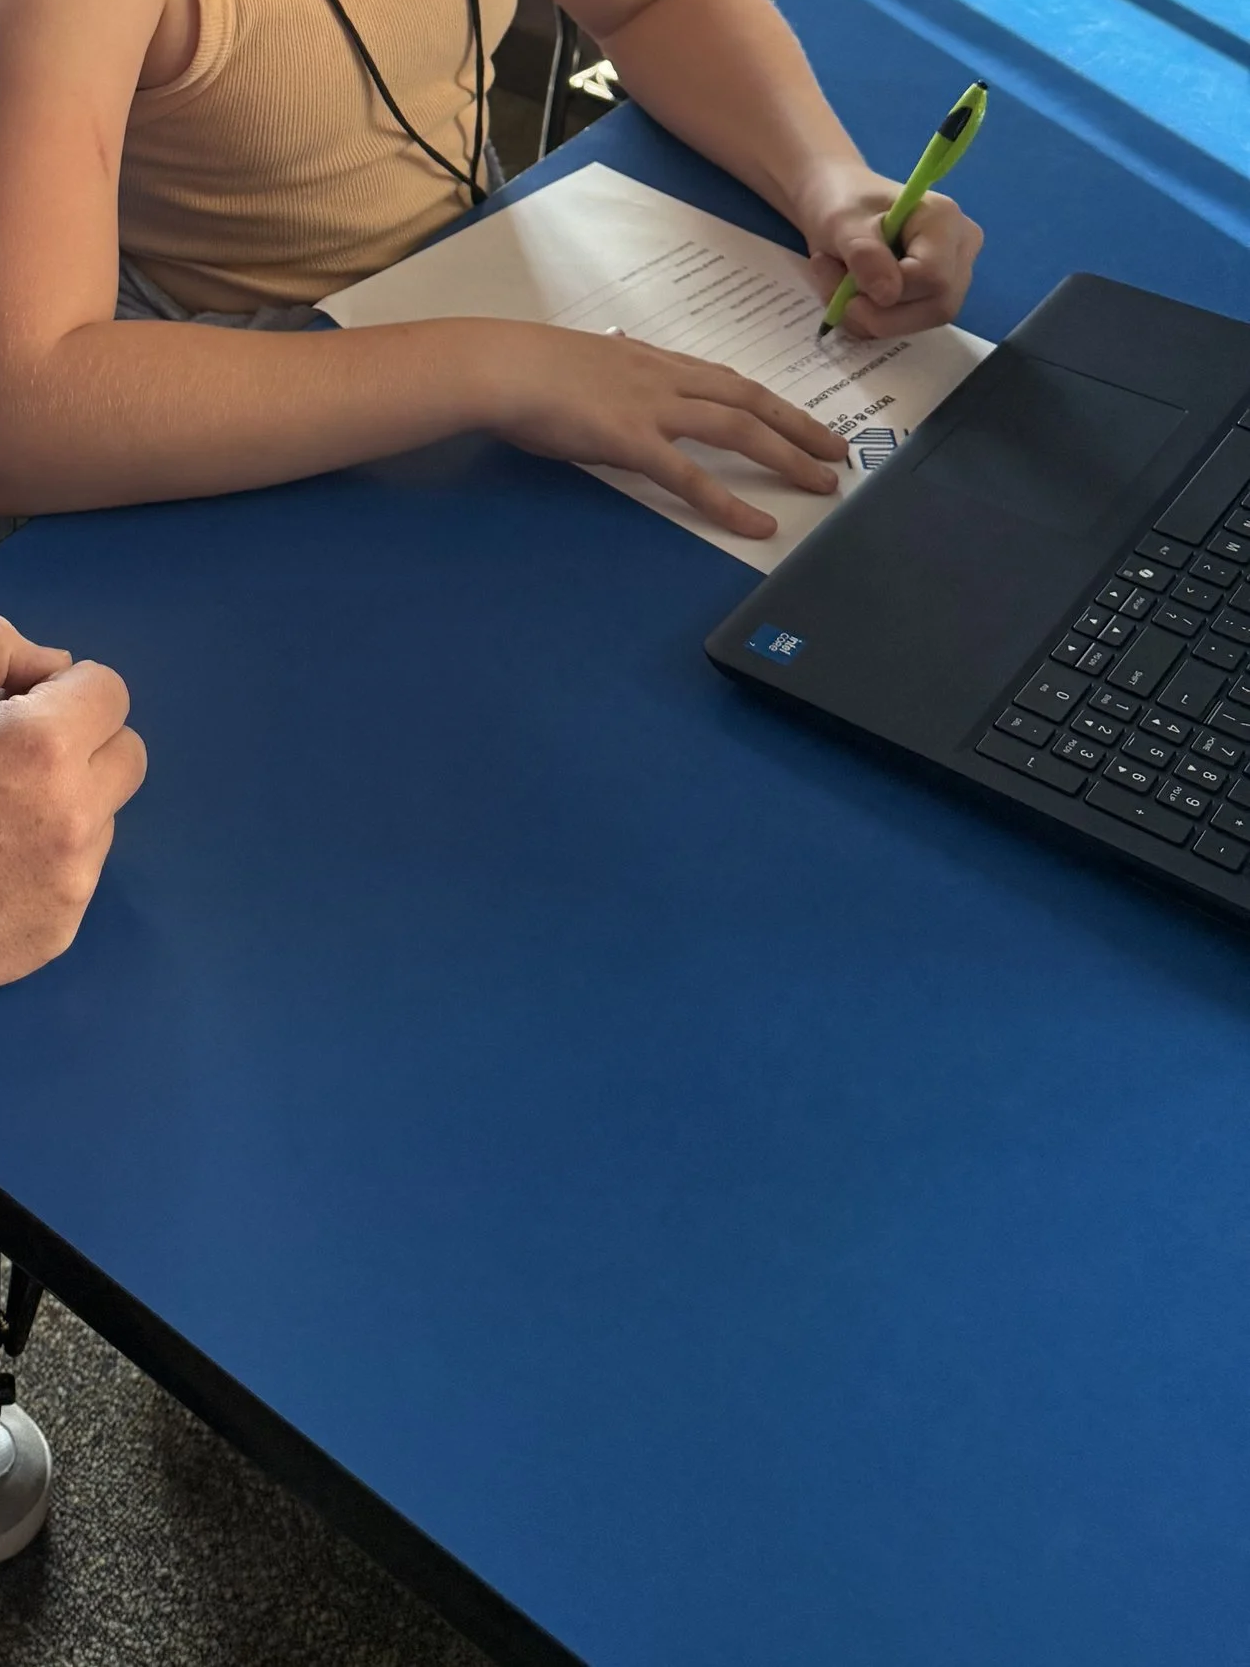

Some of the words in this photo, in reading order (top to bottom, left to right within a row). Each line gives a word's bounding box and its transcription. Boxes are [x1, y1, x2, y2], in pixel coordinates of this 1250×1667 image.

[804, 378, 850, 409] CHALLENGE
[864, 394, 897, 416] BOYS
[852, 412, 868, 421] &
[1225, 541, 1242, 553] M
[779, 636, 803, 656] intel
[1056, 691, 1070, 700] 0
[1116, 703, 1130, 711] 1
[1097, 725, 1112, 735] 2
[1166, 723, 1181, 734] 4
[1080, 749, 1094, 759] 3
[1150, 748, 1164, 758] 5
[1221, 747, 1235, 757] 7
[1132, 772, 1146, 782] 6
[1202, 771, 1217, 781] 8
[1185, 797, 1200, 807] 9
